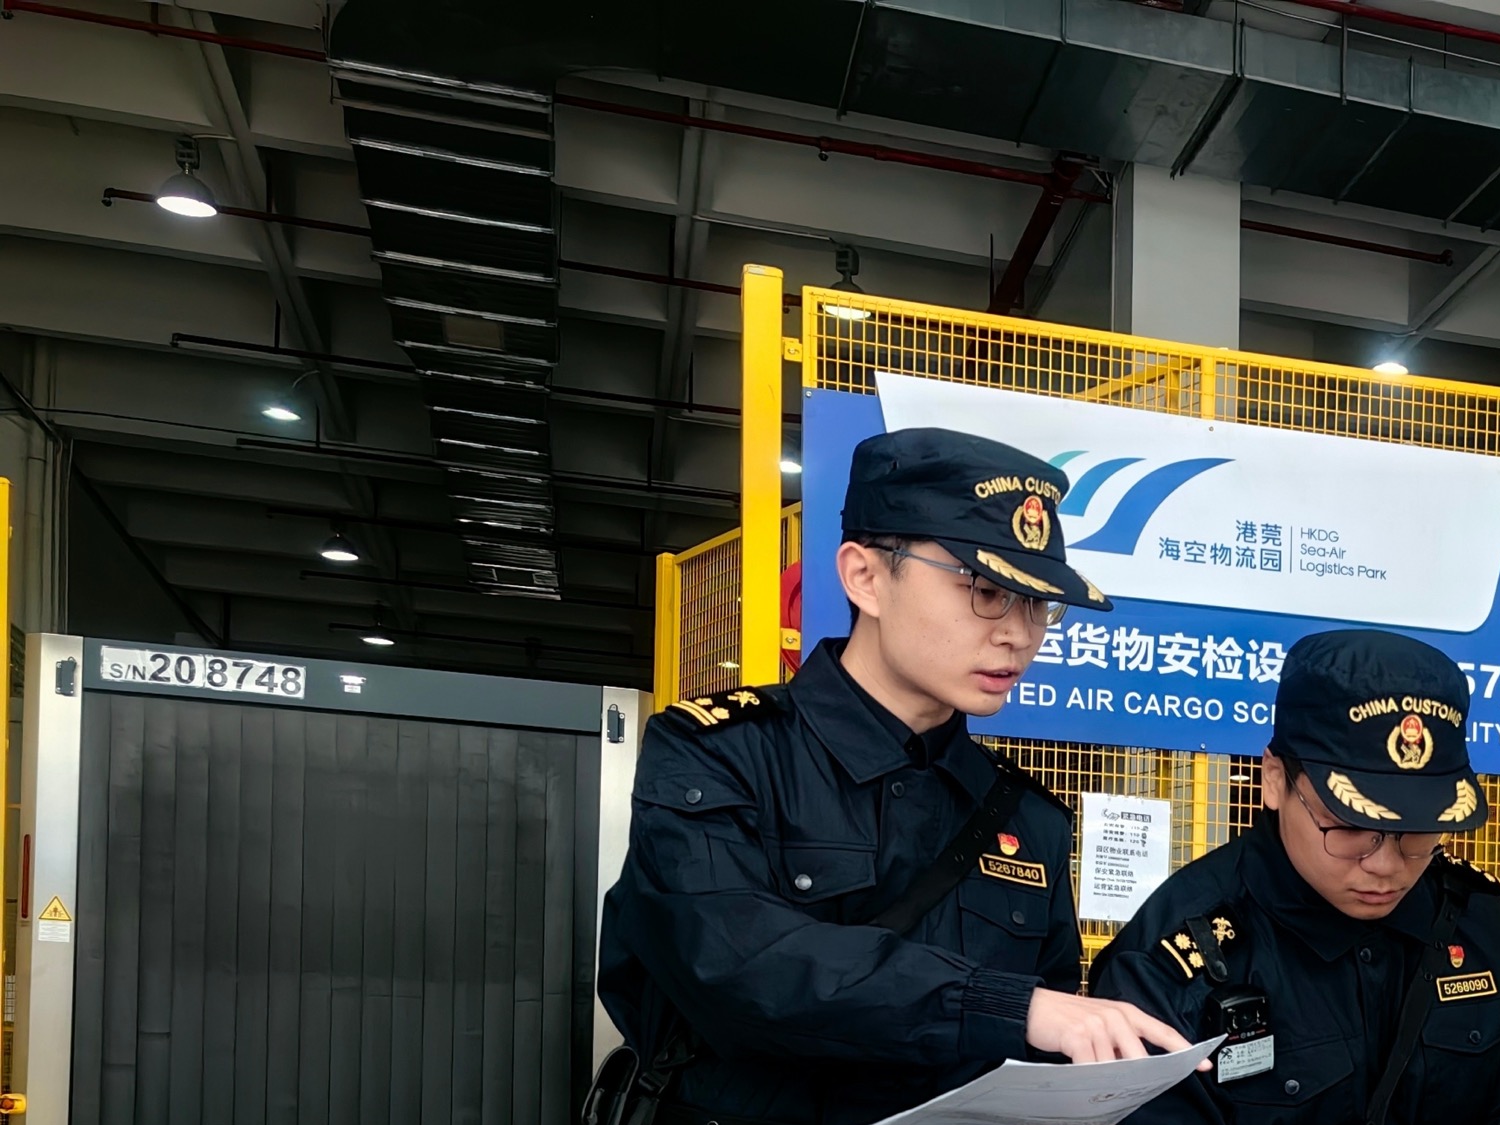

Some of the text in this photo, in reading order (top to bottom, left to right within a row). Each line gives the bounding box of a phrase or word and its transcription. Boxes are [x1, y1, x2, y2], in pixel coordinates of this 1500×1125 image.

[975, 476, 1023, 498] CHINA
[1236, 520, 1282, 546] 港莞
[1300, 527, 1339, 542] HKDG
[1159, 537, 1282, 572] 海空物流园
[1300, 543, 1346, 560] Sea-Air
[1300, 559, 1387, 580] Logistics Park
[1066, 687, 1115, 712] AIR
[1124, 691, 1224, 721] CARGO
[1349, 696, 1463, 729] CHINA CUSTOMS
[1444, 978, 1489, 995] 5268090
